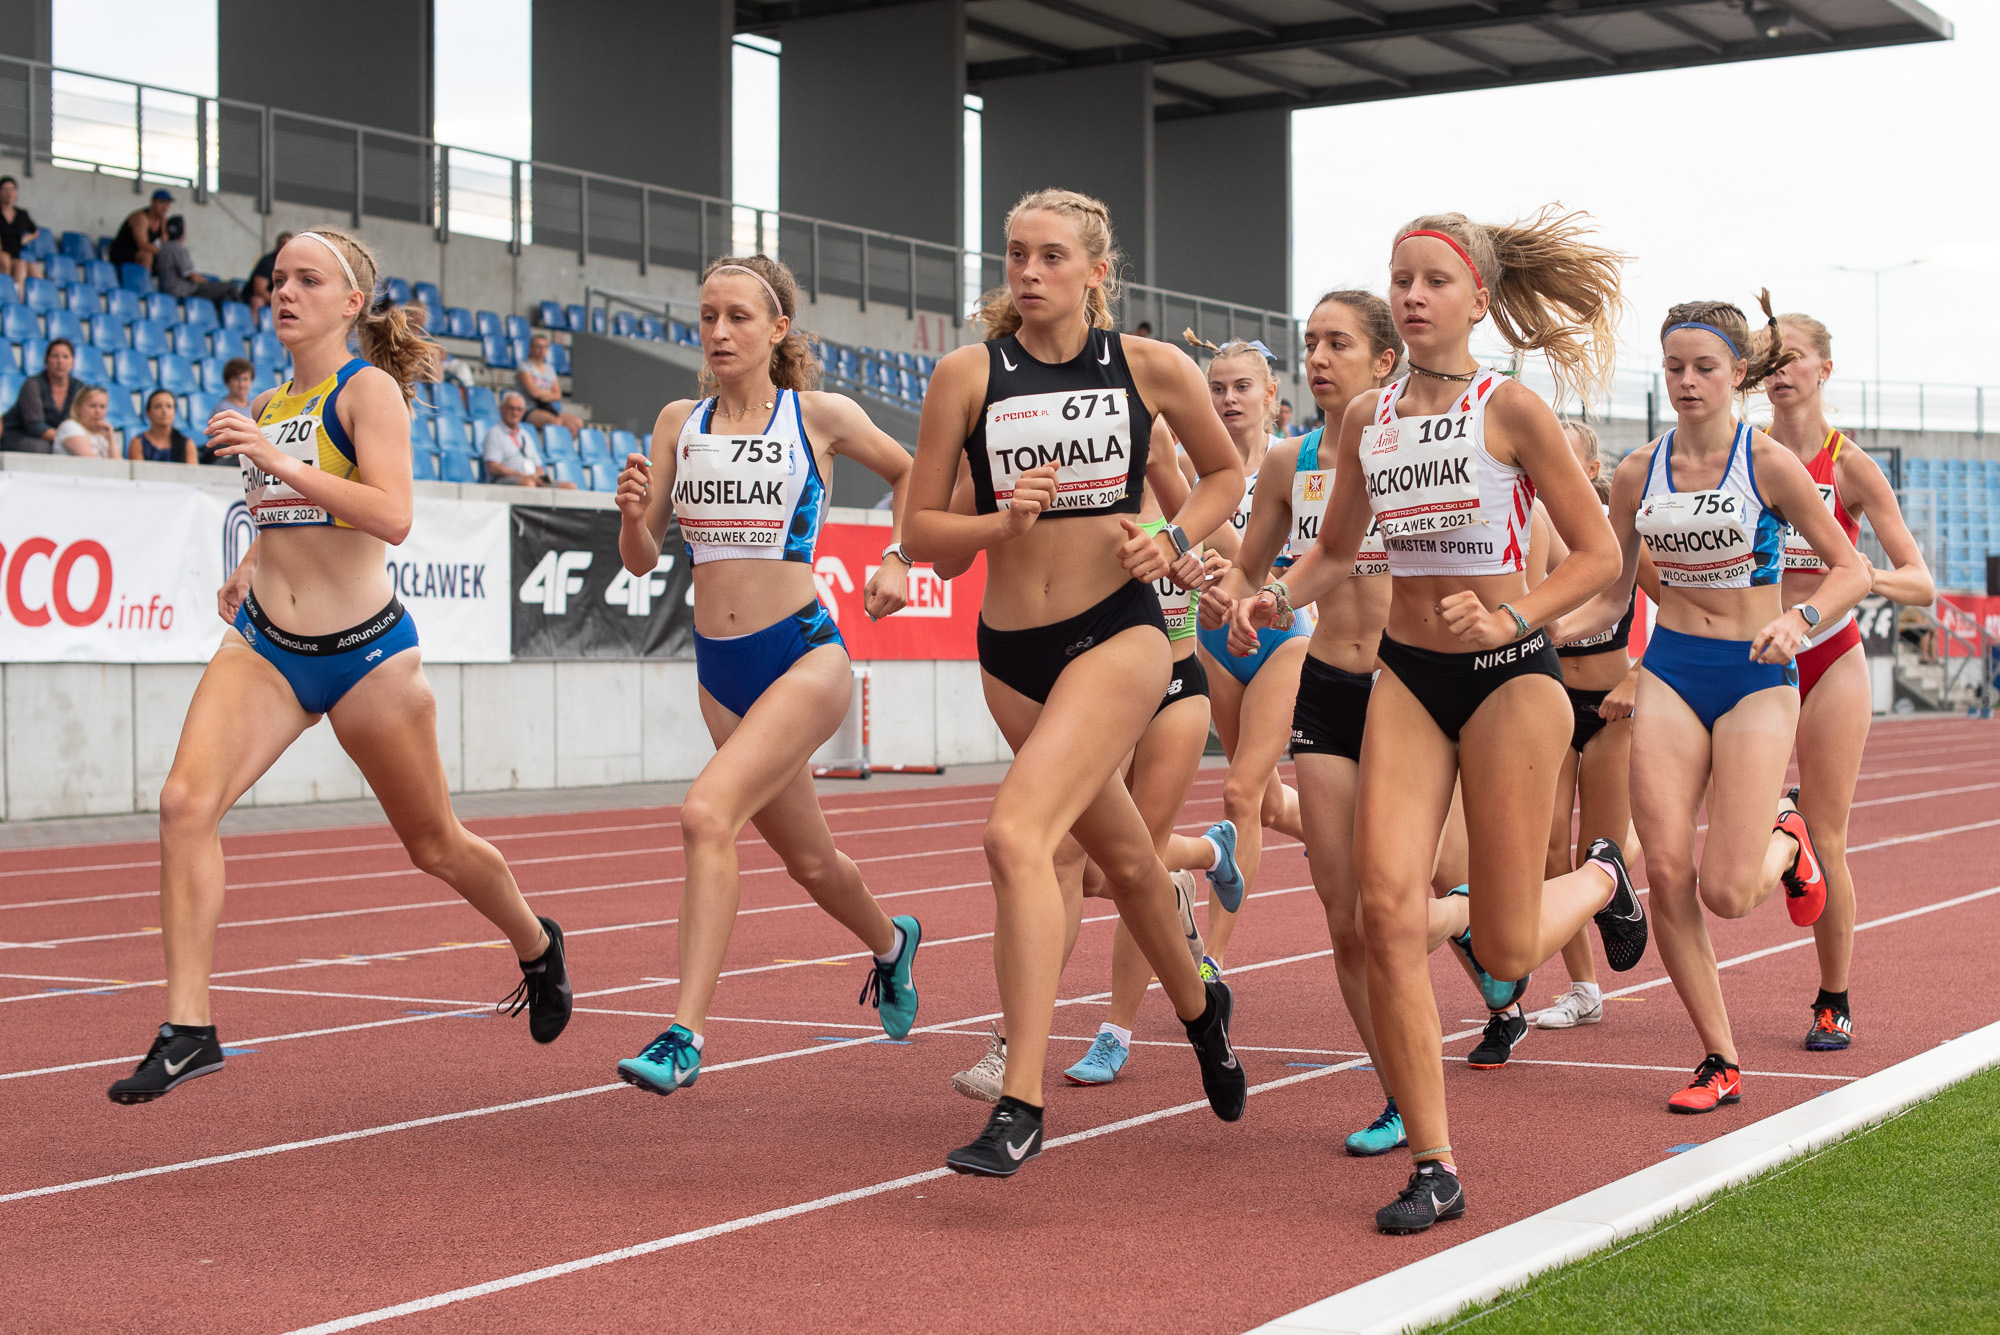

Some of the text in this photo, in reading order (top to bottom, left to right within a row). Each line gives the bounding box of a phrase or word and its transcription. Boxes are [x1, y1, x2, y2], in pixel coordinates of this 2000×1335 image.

[1062, 394, 1120, 421] 671
[275, 420, 313, 445] 720
[1418, 415, 1467, 444] 101
[731, 440, 782, 464] 753
[996, 435, 1125, 475] TOMALA
[674, 480, 784, 506] MUSIELAK
[1089, 479, 1115, 488] POLSKI
[293, 509, 320, 520] 2021
[1385, 506, 1430, 518] MISTRZOSTWA
[1430, 503, 1458, 511] POLSKI
[1693, 494, 1736, 516] 756
[685, 529, 778, 543] WŁOCŁAWEK 2021
[1382, 517, 1436, 537] OCŁAWEK
[1440, 513, 1473, 528] 2021
[1391, 539, 1437, 552] MIASTEM
[1440, 540, 1494, 555] SPORTU
[1642, 528, 1745, 552] PACHOCKA
[1366, 563, 1390, 574] 202
[1661, 563, 1751, 583] WŁOCŁAWEK 2021
[1800, 558, 1823, 567] 2021
[387, 561, 485, 598] OCŁAWEK
[519, 550, 593, 615] 4F
[336, 612, 396, 649] AdRunaLine
[1165, 617, 1186, 627] 2021
[1587, 633, 1607, 645] 2021
[1473, 634, 1545, 671] NIKE PRO
